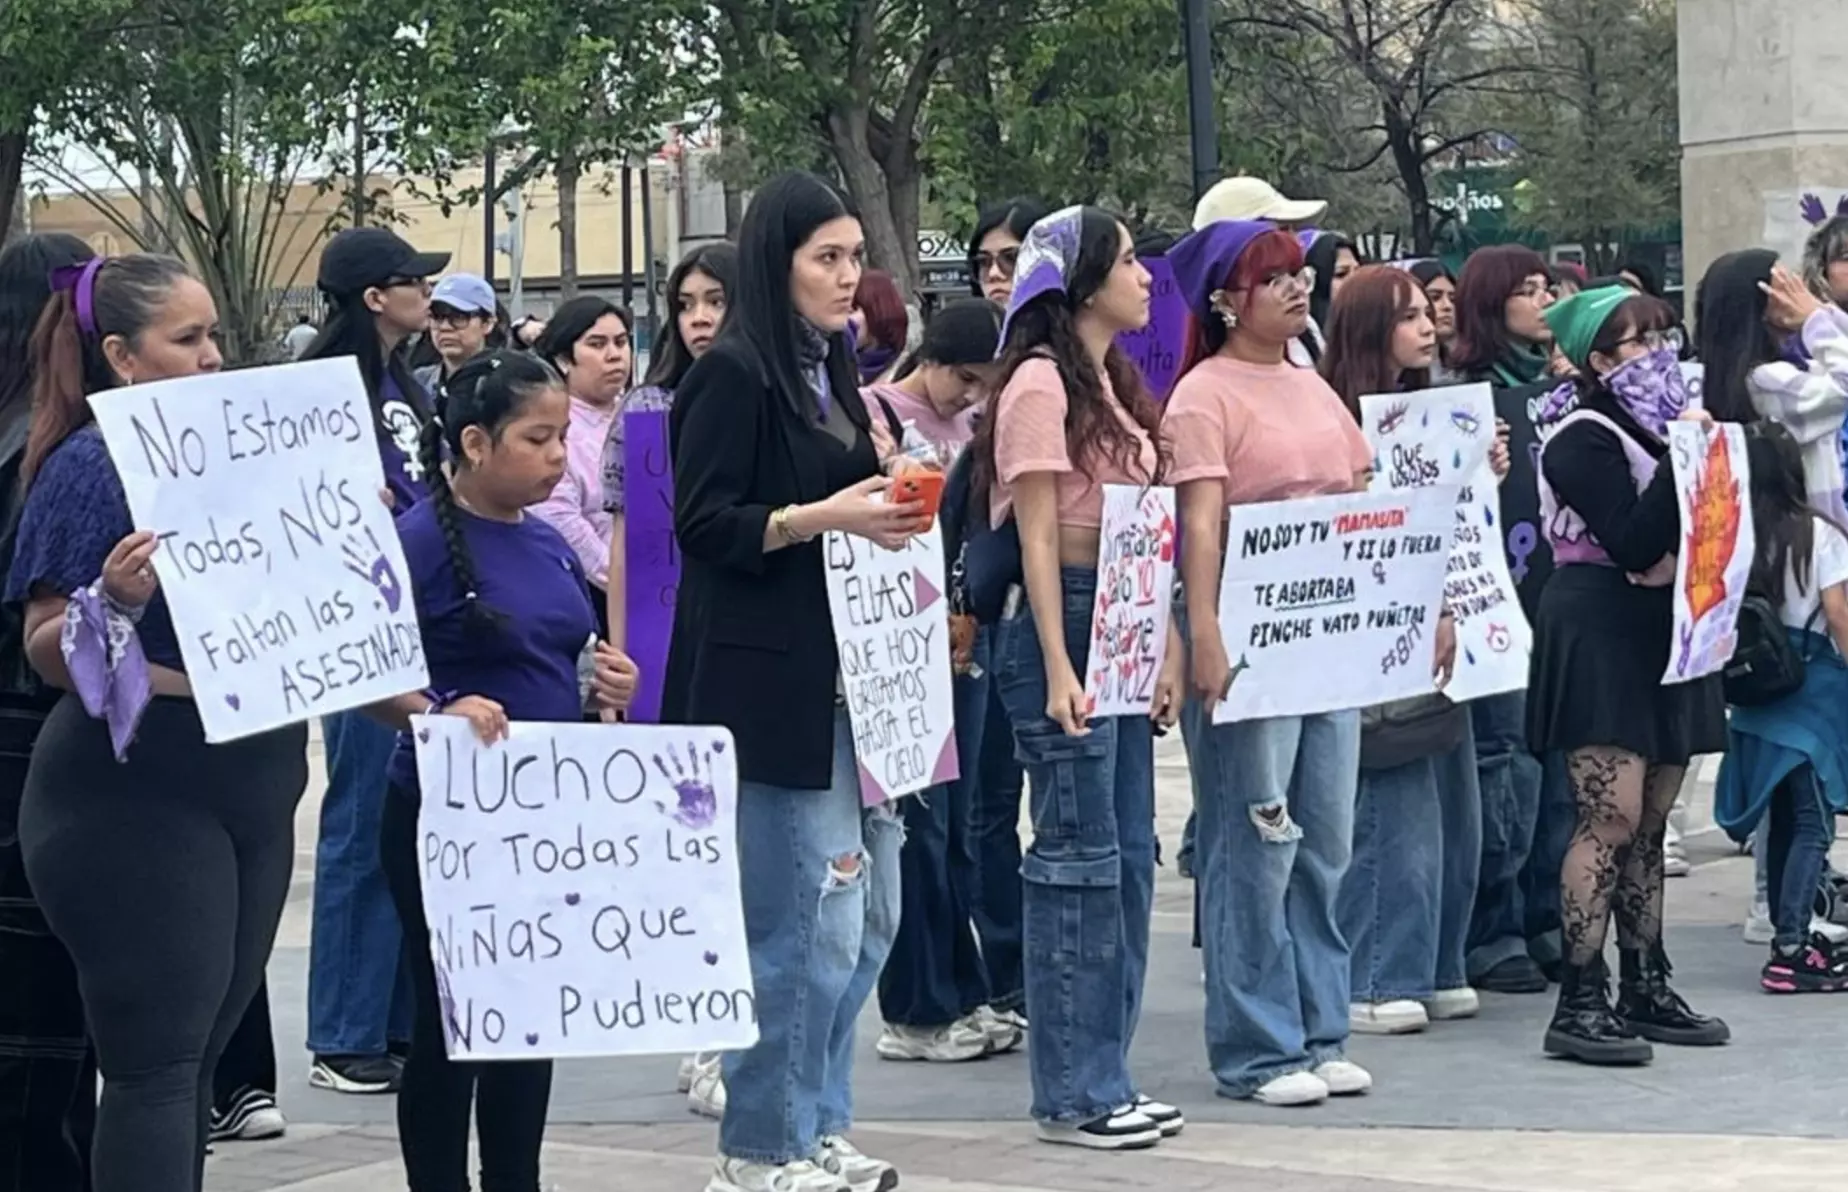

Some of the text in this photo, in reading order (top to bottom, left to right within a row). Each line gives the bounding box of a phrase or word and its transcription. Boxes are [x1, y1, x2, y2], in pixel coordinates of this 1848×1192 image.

[222, 399, 362, 462] Estamos
[1310, 519, 1330, 543] TU
[1343, 533, 1442, 561] Y SI LO FUERA
[844, 570, 915, 627] ELLAS
[1254, 576, 1356, 608] TE ABORTABA
[198, 589, 355, 673] Faltan las
[841, 621, 936, 677] QUE HOY
[1249, 617, 1314, 648] PINCHE
[1322, 612, 1360, 636] VATO
[907, 703, 933, 739] EL
[884, 742, 926, 790] CIELO
[560, 979, 758, 1038] Pudieron
